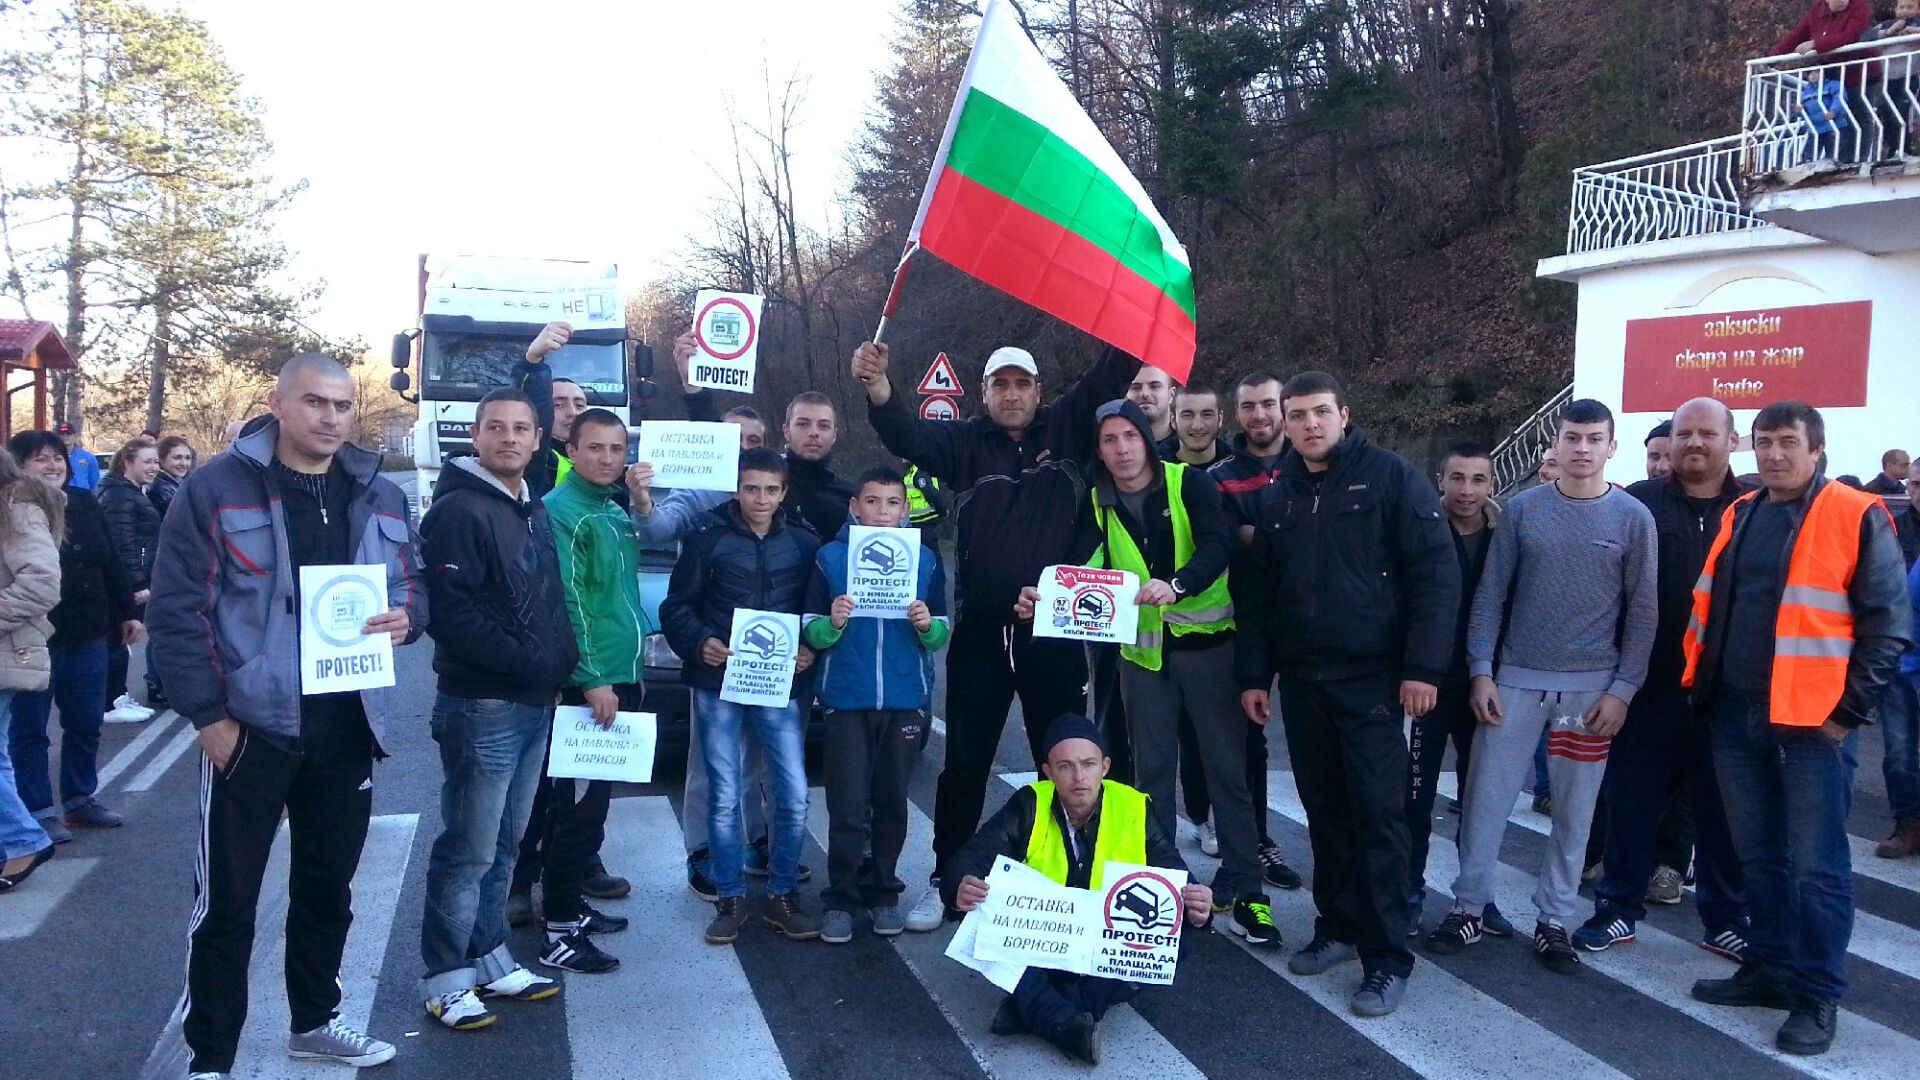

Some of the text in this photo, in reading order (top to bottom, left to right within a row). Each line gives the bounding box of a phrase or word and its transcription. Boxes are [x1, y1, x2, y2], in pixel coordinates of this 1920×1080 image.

[1704, 313, 1782, 337] закуски
[1675, 345, 1805, 371] скара на жар
[696, 365, 749, 387] ПРОТЕСТ!
[1712, 377, 1764, 398] кафе
[660, 433, 715, 445] ОСТАВКА
[651, 448, 665, 458] НА
[668, 449, 715, 460] ПАВЛОВА
[661, 464, 713, 474] БОРИСОВ
[853, 577, 911, 587] ПРОТЕСТ!
[1074, 620, 1111, 629] ПРОТЕСТ!
[316, 653, 383, 679] ПРОТЕСТ!
[732, 659, 789, 672] ПРОТЕСТ!
[736, 680, 776, 689] ПЛАЩАМ
[563, 737, 578, 747] НА
[581, 738, 630, 750] ПАВЛОВА
[574, 753, 627, 765] БОРИСОВ
[1412, 727, 1423, 800] LEVSKI
[1006, 894, 1075, 914] ОСТАВКА
[992, 914, 1009, 927] НА
[1013, 918, 1072, 935] ПАВЛОВА
[1003, 936, 1070, 954] БОРИСОВ
[1102, 929, 1177, 947] ПРОТЕСТ!
[1101, 947, 1176, 963] АЗ НЯМА ДА
[1109, 958, 1163, 971] ПЛАЩАМ
[1096, 965, 1173, 980] СКЪПИ ВИНЕТКИ!
